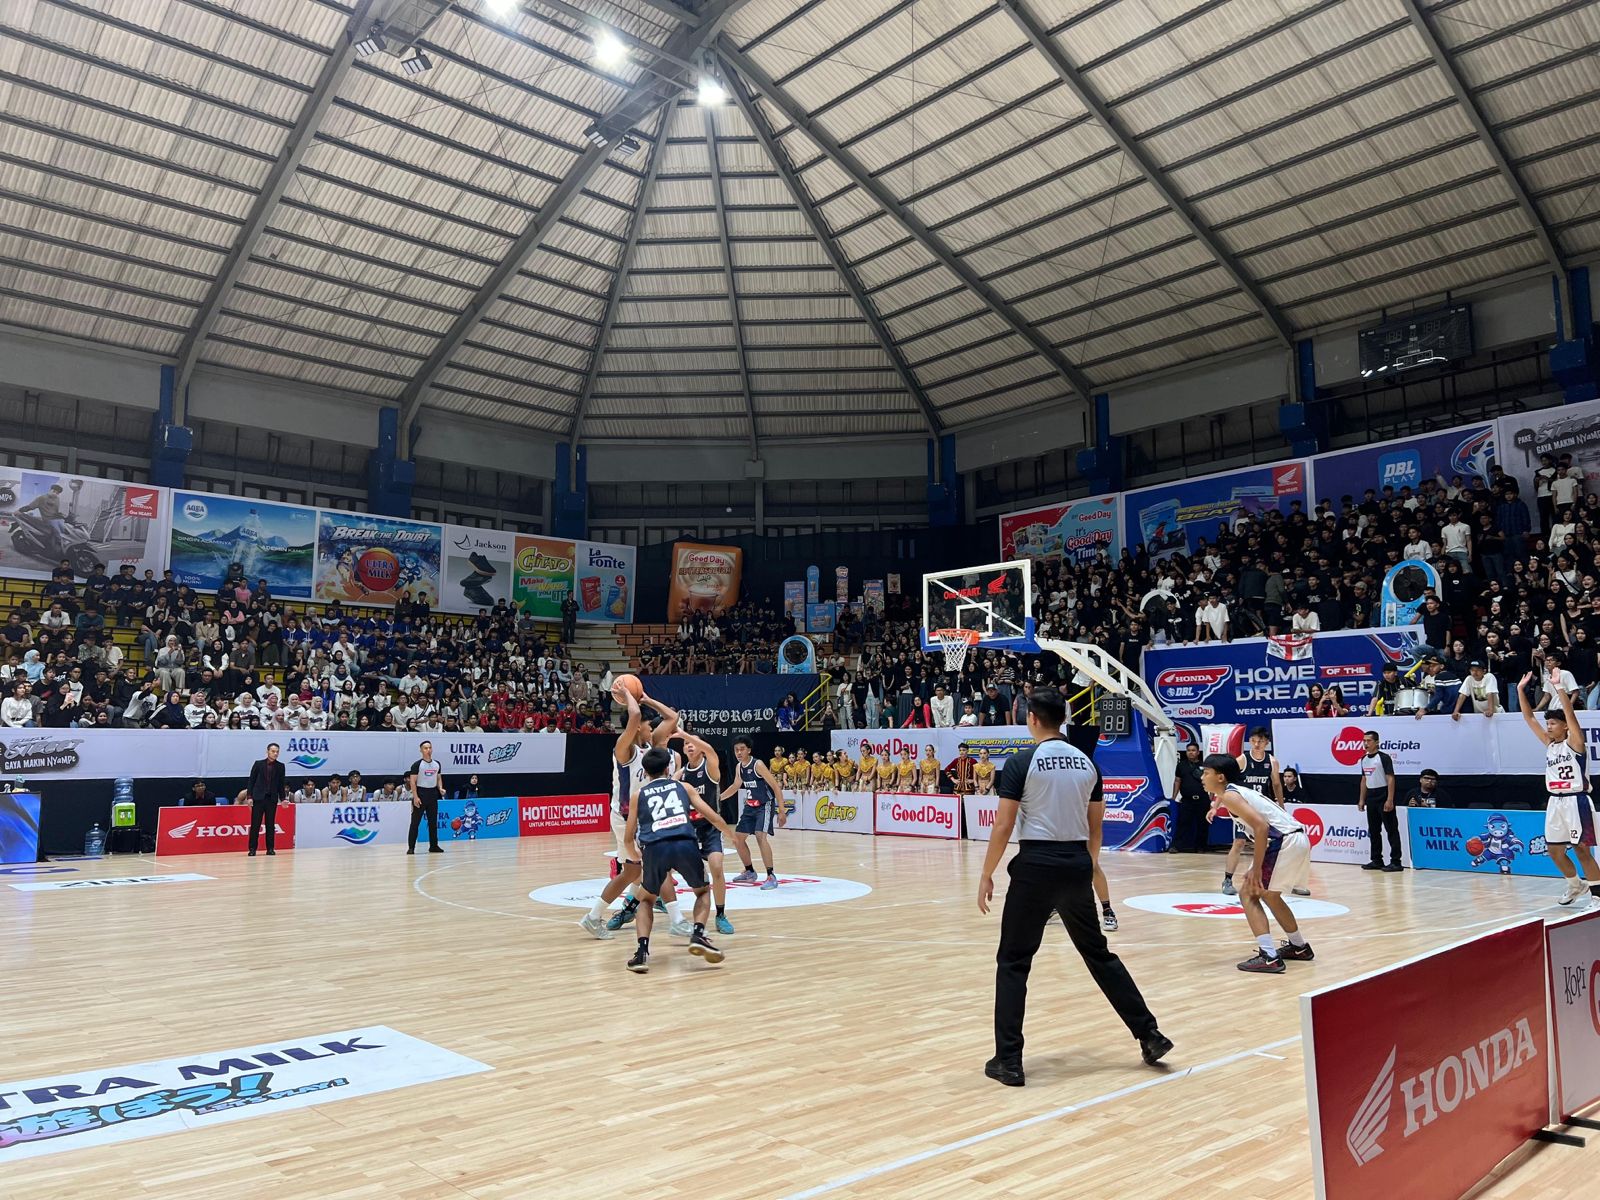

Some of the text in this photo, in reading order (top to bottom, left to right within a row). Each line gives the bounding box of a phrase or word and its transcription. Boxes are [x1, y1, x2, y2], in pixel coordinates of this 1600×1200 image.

[1517, 434, 1533, 444] PAKE
[1536, 443, 1553, 454] GAYA
[1553, 437, 1575, 450] MAKIN
[1385, 460, 1416, 477] DBL
[1384, 474, 1416, 484] PLAY
[1079, 512, 1097, 521] Good
[1097, 511, 1111, 519] Day
[331, 526, 379, 540] BREAK
[393, 530, 431, 542] DOUBT
[1067, 530, 1112, 549] Good Day
[474, 539, 507, 551] Jackson
[589, 548, 601, 556] La
[365, 560, 394, 570] ULTRA
[589, 556, 625, 569] Fonte
[689, 553, 725, 566] Good Day
[367, 569, 392, 579] MILK
[1175, 674, 1213, 683] HONDA
[1234, 664, 1366, 684] HOME OF THE
[1175, 687, 1194, 697] DBL
[1234, 681, 1377, 702] DREAER
[1179, 707, 1212, 716] Good Day
[287, 738, 329, 754] AQUA
[450, 744, 484, 754] ULTRA
[1377, 740, 1420, 752] dicipta
[5, 760, 21, 770] GAYA
[23, 758, 45, 768] MAKIN
[453, 755, 480, 765] MILK
[1036, 756, 1087, 772] REFEREE
[1558, 766, 1574, 780] 22
[522, 806, 547, 821] HOT
[563, 803, 603, 818] CREAM
[647, 790, 685, 821] 24
[330, 807, 380, 827] AQUA
[892, 803, 925, 821] Good
[927, 805, 953, 829] Day
[1120, 812, 1132, 821] Day
[1419, 826, 1462, 839] ULTRA
[1324, 839, 1355, 848] Motora
[1426, 840, 1460, 852] MILK
[178, 1036, 386, 1081] MILK
[1400, 1017, 1538, 1138] HONDA
